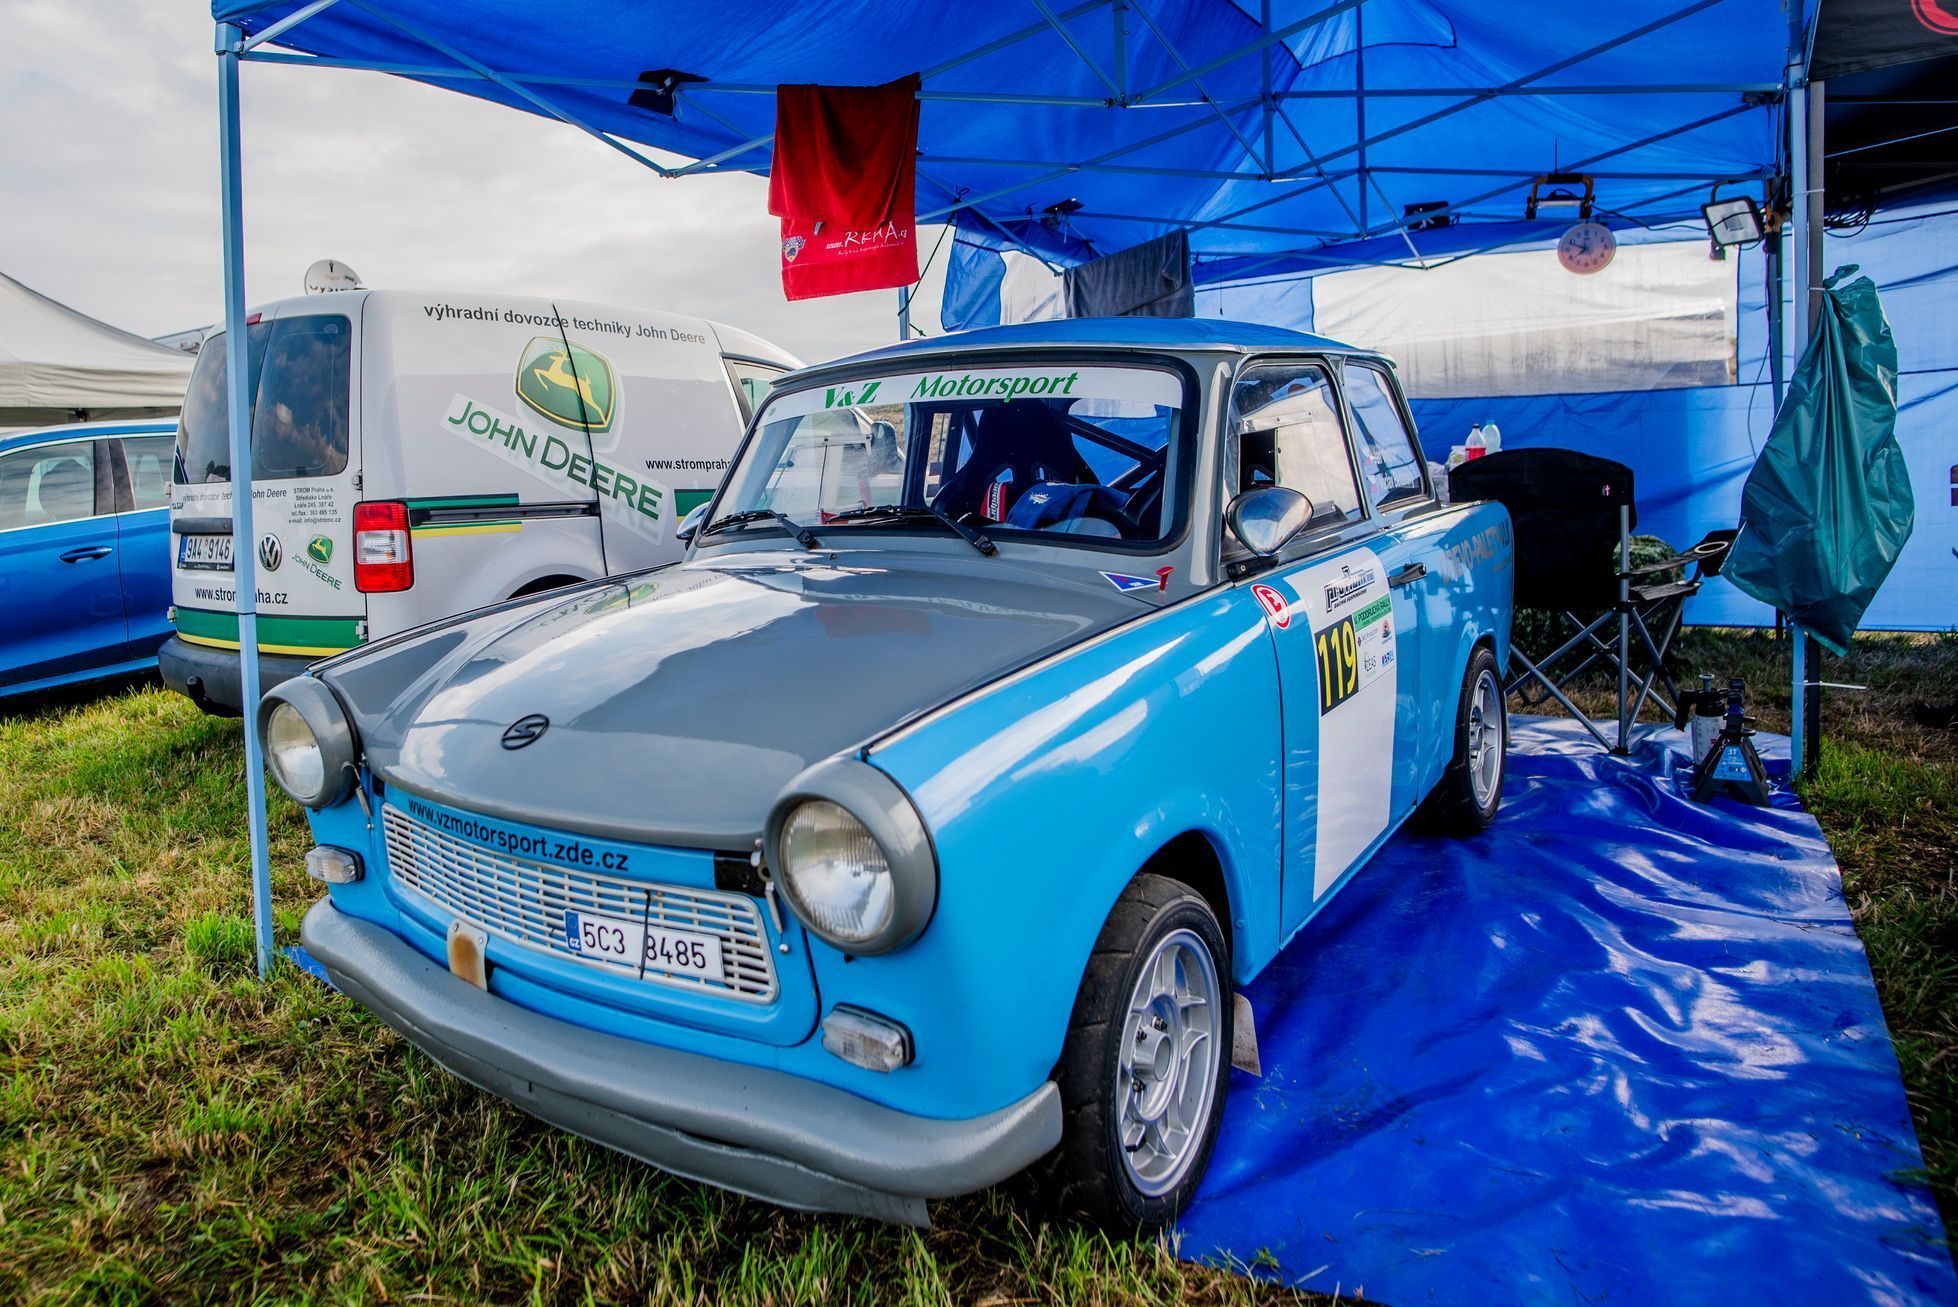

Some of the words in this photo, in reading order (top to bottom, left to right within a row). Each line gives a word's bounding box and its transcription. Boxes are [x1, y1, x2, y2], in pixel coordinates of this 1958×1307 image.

[424, 303, 499, 321] výhradní
[504, 310, 568, 328] dovozce
[573, 317, 631, 338] techniky
[636, 324, 667, 340] John
[671, 328, 705, 344] Deere
[824, 381, 882, 409] V&Z
[910, 372, 1078, 403] Motorsport
[448, 401, 537, 459] JOHN
[540, 435, 662, 521] DEERE
[267, 488, 287, 498] Deere
[187, 538, 201, 560] 9A4
[208, 538, 231, 560] 9146
[292, 553, 310, 570] JOHN
[310, 563, 342, 590] DEERE
[1318, 620, 1358, 707] 119
[408, 798, 629, 871] www.vzmotorsport.zde.cz
[569, 937, 581, 948] CZ
[583, 921, 625, 954] 5C3
[646, 934, 706, 969] 8485
